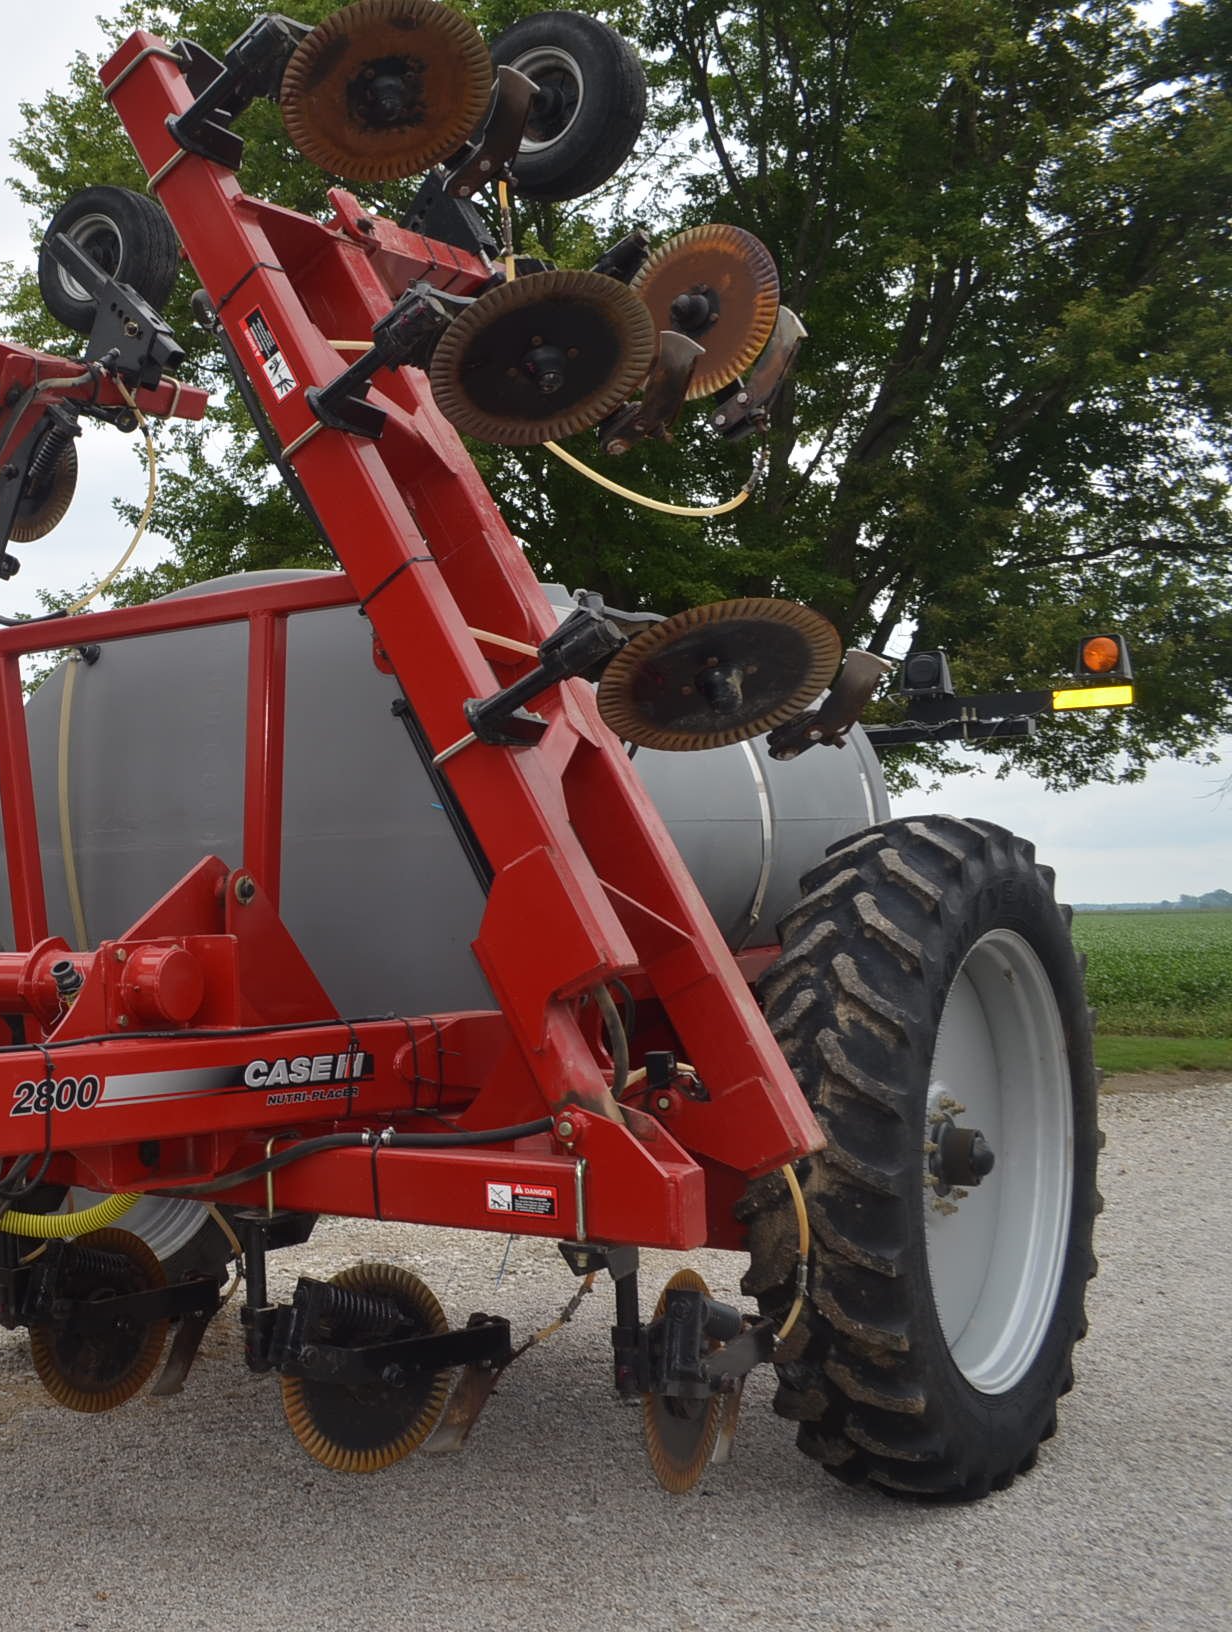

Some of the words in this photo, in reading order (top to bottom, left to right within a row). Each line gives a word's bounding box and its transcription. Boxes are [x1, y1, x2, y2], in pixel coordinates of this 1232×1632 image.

[244, 1055, 334, 1088] CASE
[9, 1075, 100, 1117] 2800
[267, 1086, 360, 1106] NUTRI-PLACER
[523, 1187, 552, 1197] DANGER
